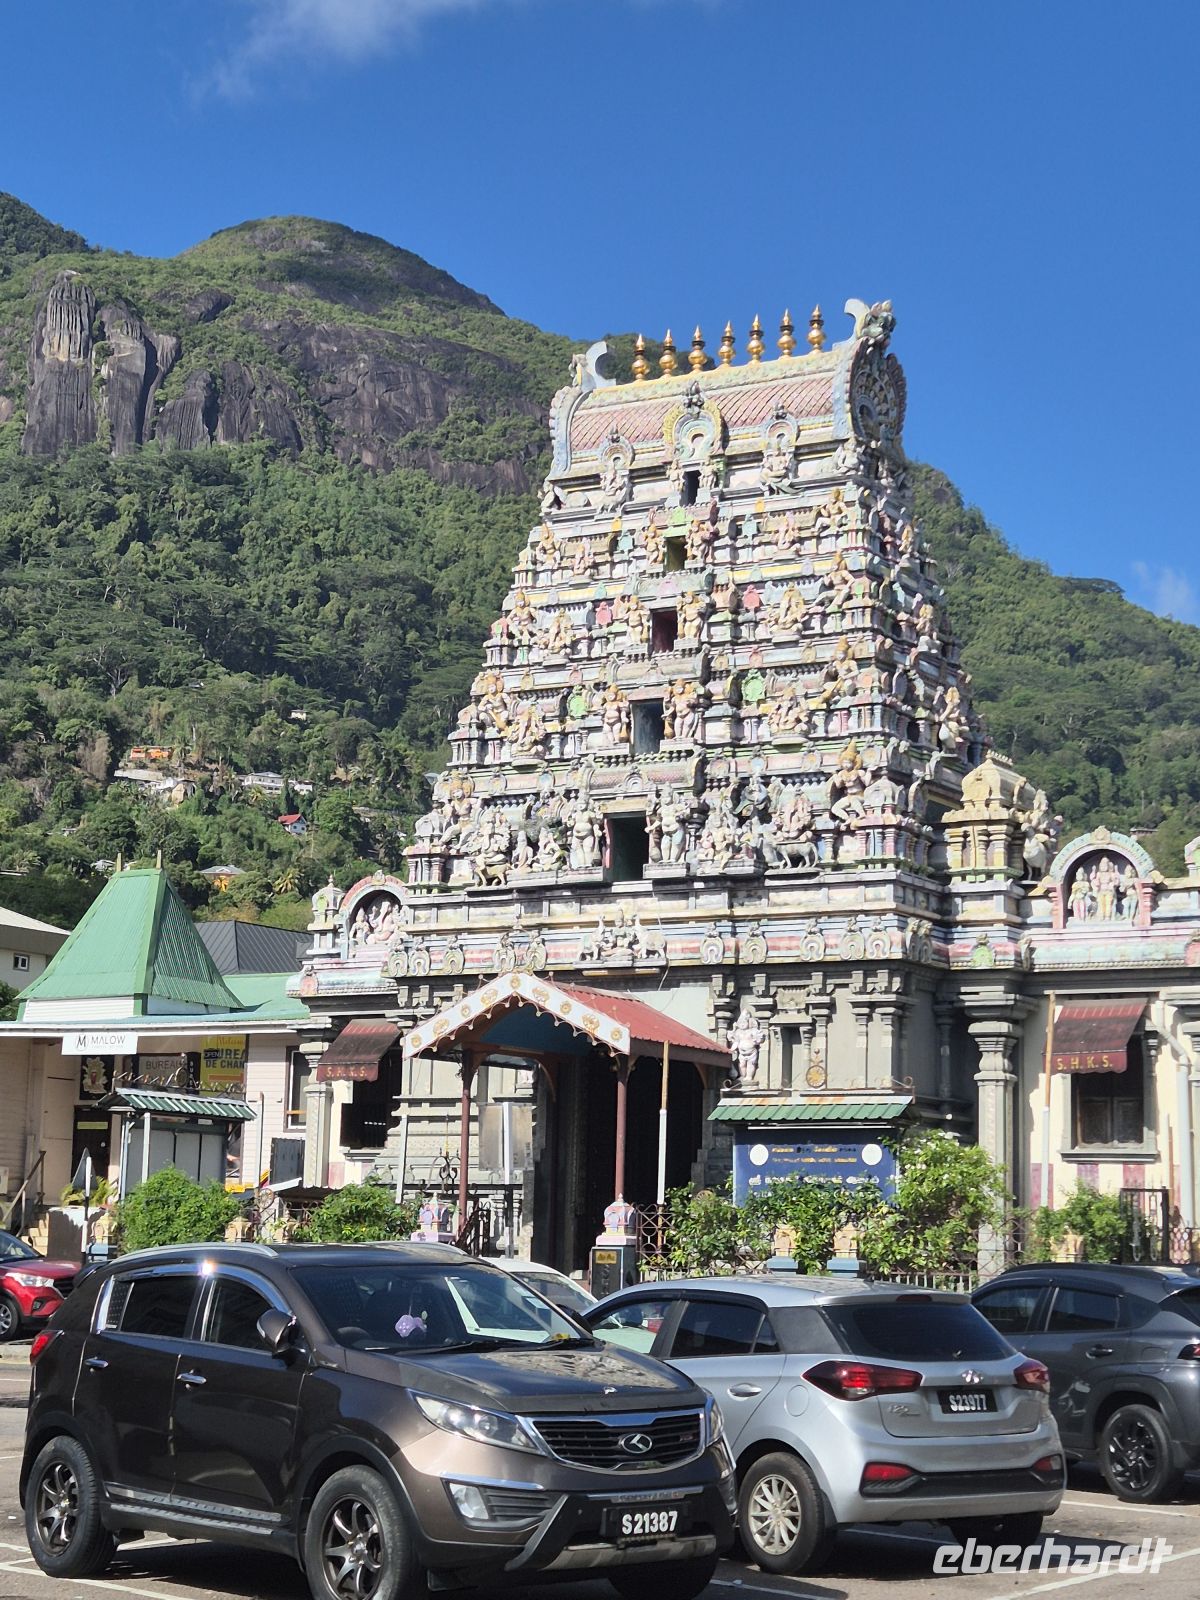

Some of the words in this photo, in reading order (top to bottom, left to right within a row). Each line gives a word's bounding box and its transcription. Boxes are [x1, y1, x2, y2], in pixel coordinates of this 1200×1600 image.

[91, 1035, 126, 1045] MALOW
[205, 1059, 217, 1069] DE
[949, 1394, 988, 1412] S23977
[621, 1510, 678, 1535] S21387
